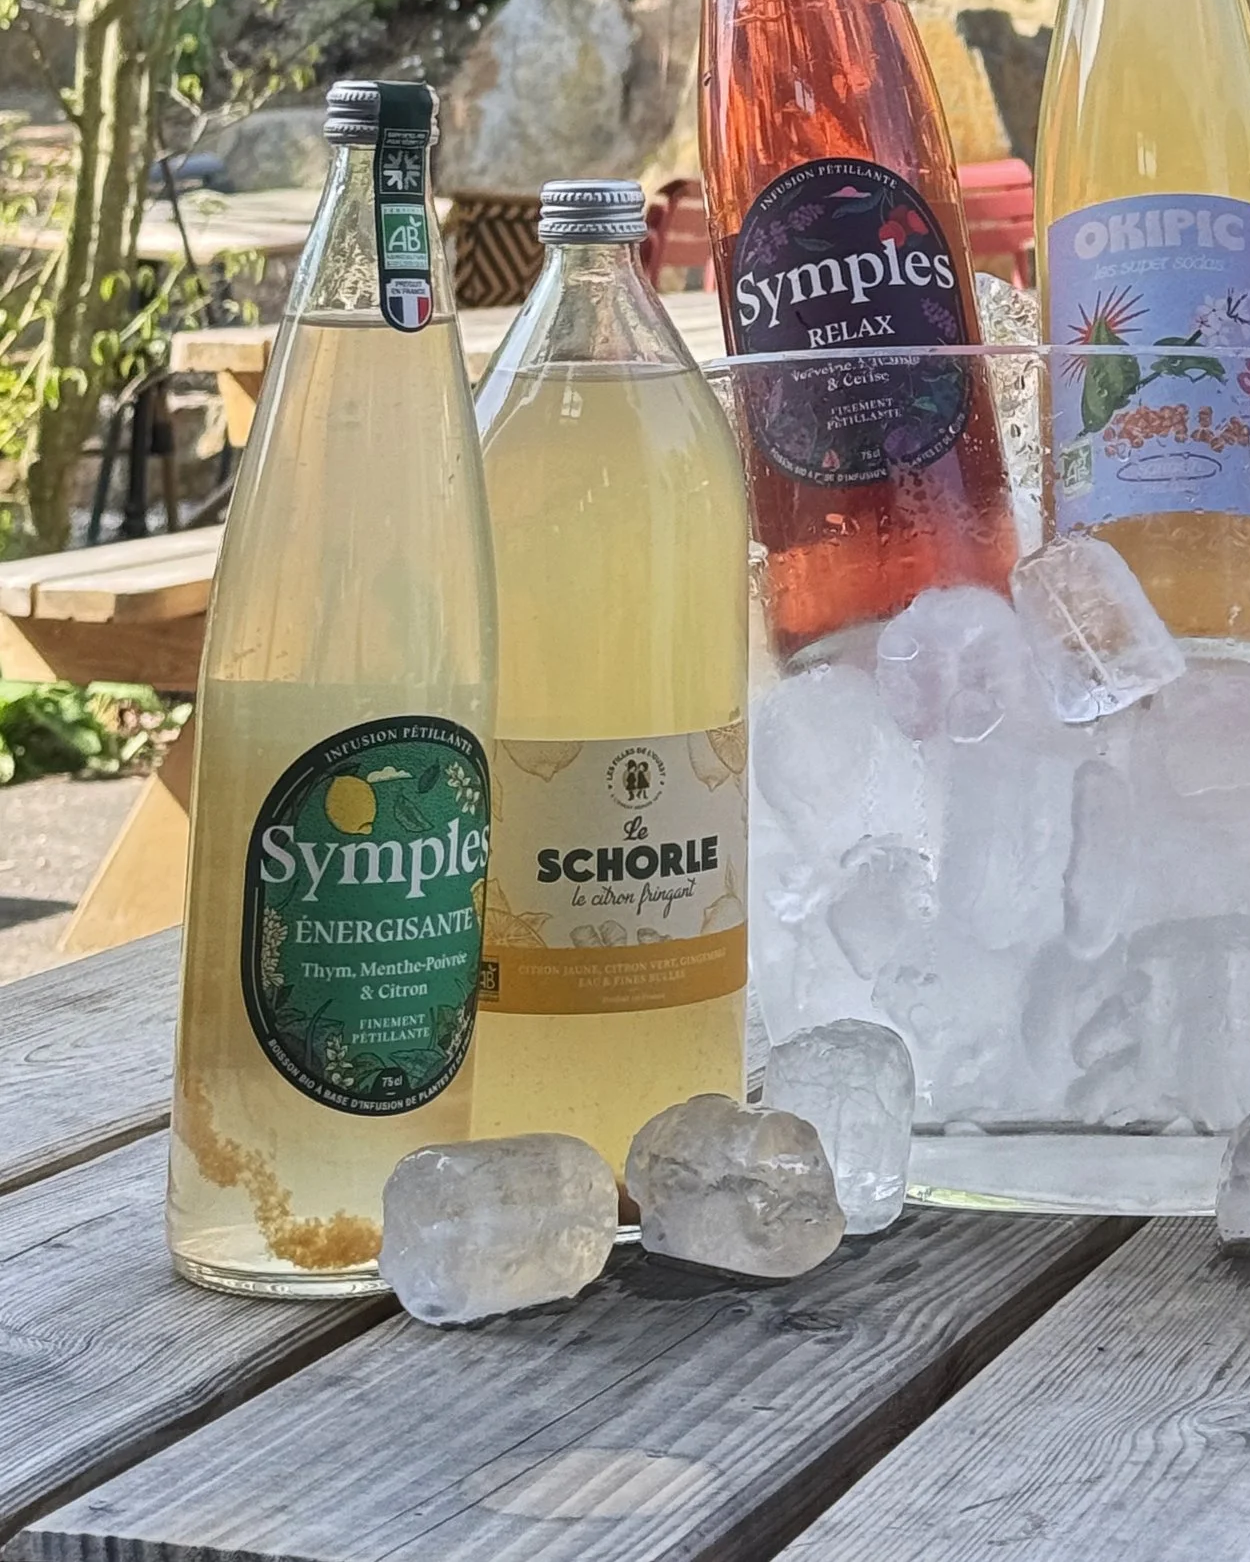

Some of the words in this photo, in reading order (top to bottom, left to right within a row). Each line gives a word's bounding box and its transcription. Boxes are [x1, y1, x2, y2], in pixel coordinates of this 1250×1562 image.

[760, 169, 814, 211] INFUSION
[818, 164, 897, 189] PÉTILLANTE
[388, 225, 421, 251] AB
[1074, 209, 1245, 260] OKIPIC
[1121, 256, 1169, 276] super
[736, 238, 954, 328] Symples
[807, 315, 896, 348] RELAX
[827, 378, 838, 391] &
[324, 728, 398, 763] INFUSION
[403, 724, 473, 756] PÉTILLANTE
[623, 815, 648, 841] Le
[260, 817, 489, 902] Symples
[537, 835, 718, 883] SCHORLE
[571, 886, 586, 907] le
[591, 885, 635, 906] citron
[636, 877, 696, 919] fringant
[295, 907, 473, 944] ÉNERGISANTE
[301, 962, 357, 981] Thym,
[360, 986, 374, 1000] &
[378, 983, 428, 999] Citron
[351, 1026, 430, 1044] PÉTILLANTE
[359, 1014, 426, 1030] FINEMENT
[268, 1038, 299, 1077] BOISSON
[298, 1073, 316, 1089] BIO
[323, 1090, 350, 1107] BASE
[350, 1100, 404, 1111] D'INFUSION
[405, 1096, 417, 1107] DE
[382, 1076, 403, 1088] 75cl
